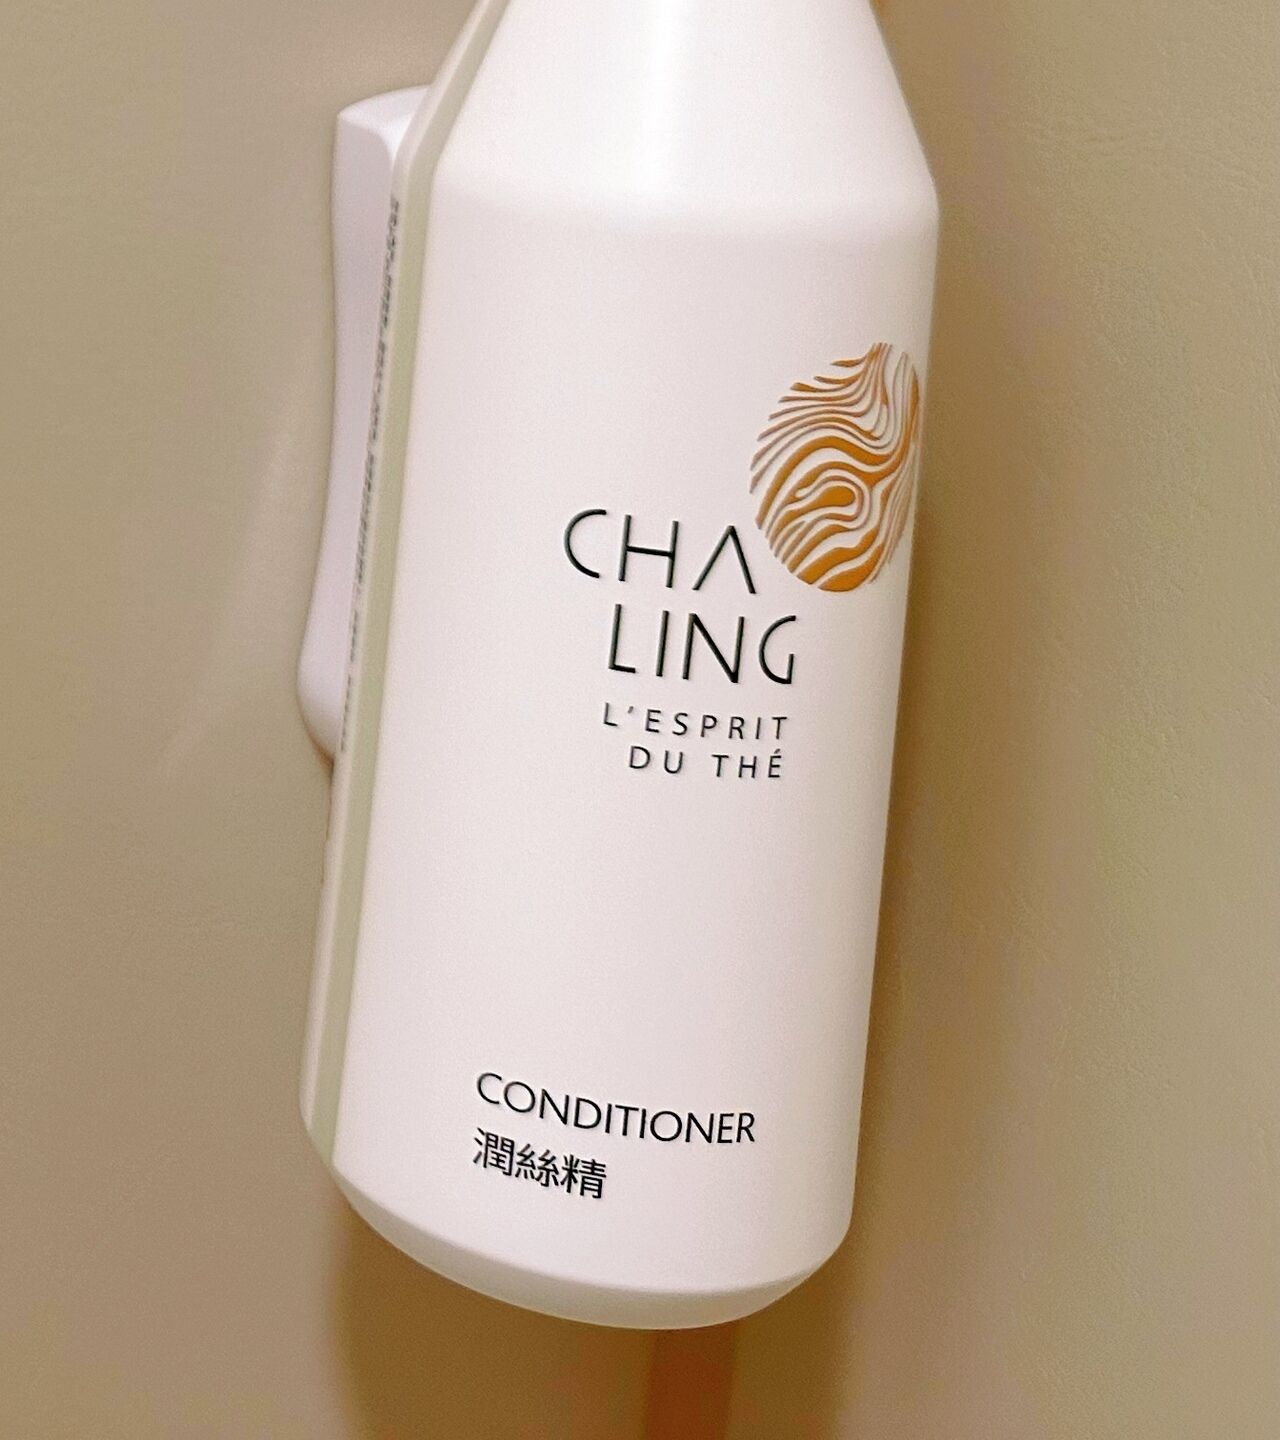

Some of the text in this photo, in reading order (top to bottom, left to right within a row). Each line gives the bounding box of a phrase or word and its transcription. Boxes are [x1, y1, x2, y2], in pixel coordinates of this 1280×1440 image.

[563, 508, 756, 595] CHA
[608, 603, 796, 685] LING
[603, 702, 788, 740] L'ESPRIT
[628, 745, 782, 778] DU THÉ
[476, 1072, 755, 1144] CONDITIONER
[472, 1127, 607, 1199] 潤絲精
